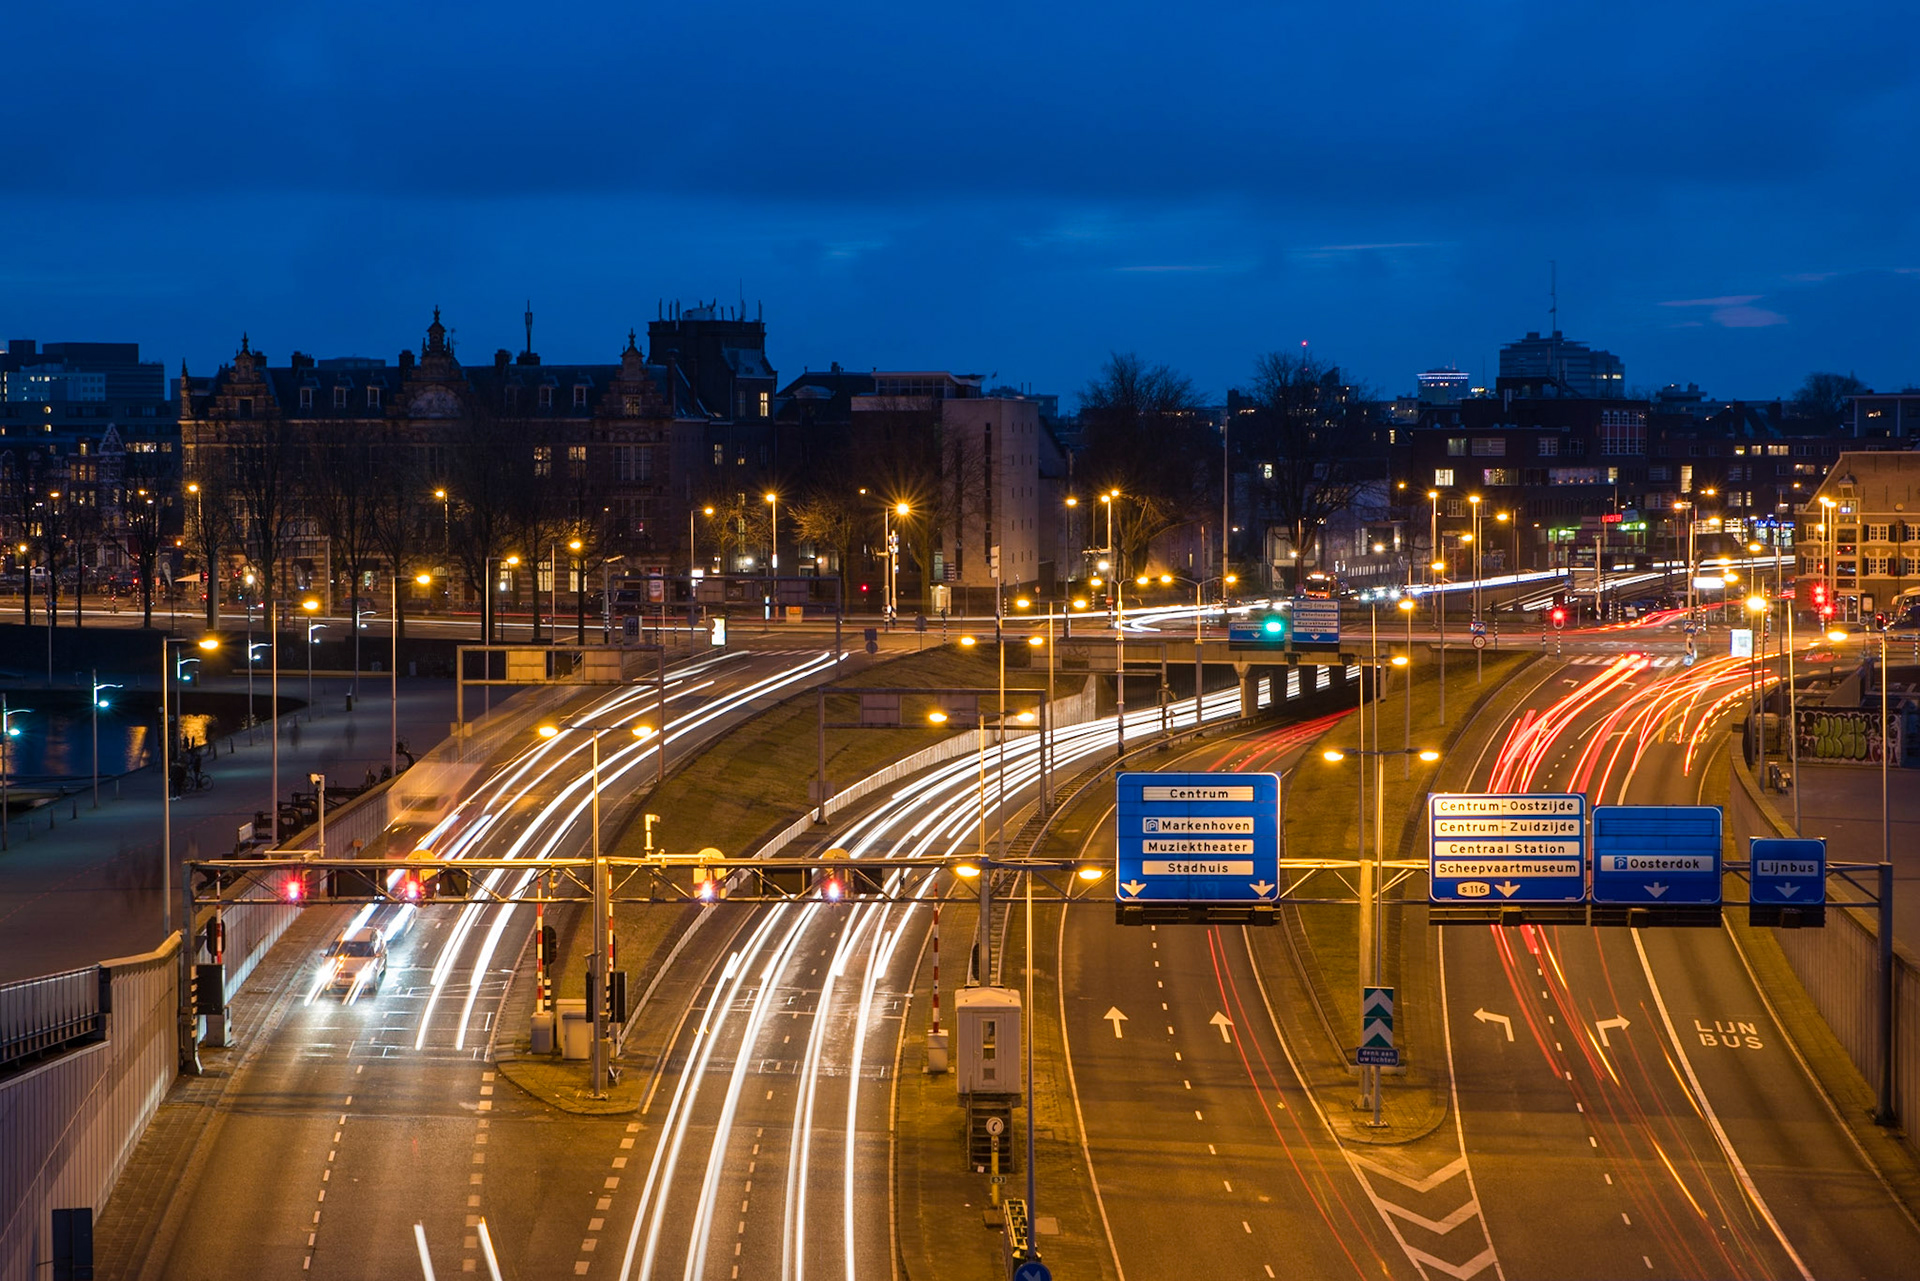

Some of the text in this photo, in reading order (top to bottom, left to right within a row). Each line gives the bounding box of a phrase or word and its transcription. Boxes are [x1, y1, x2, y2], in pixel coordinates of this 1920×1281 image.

[1170, 789, 1229, 798] Centrum
[1441, 802, 1574, 812] Centrum-Oostzijde
[1162, 820, 1250, 830] Markenhoven
[1440, 822, 1574, 834] Centrum-Zuidzijde
[1148, 842, 1248, 851] Muziektheater
[1450, 844, 1565, 853] Centraal Station
[1168, 863, 1228, 872] Stadhuis
[1630, 859, 1700, 868] Oosterdok
[1761, 862, 1814, 874] Lijnbus
[1440, 864, 1576, 874] Scheepvaartmuseum
[1694, 1020, 1758, 1035] LIJN
[1699, 1033, 1763, 1050] BUS
